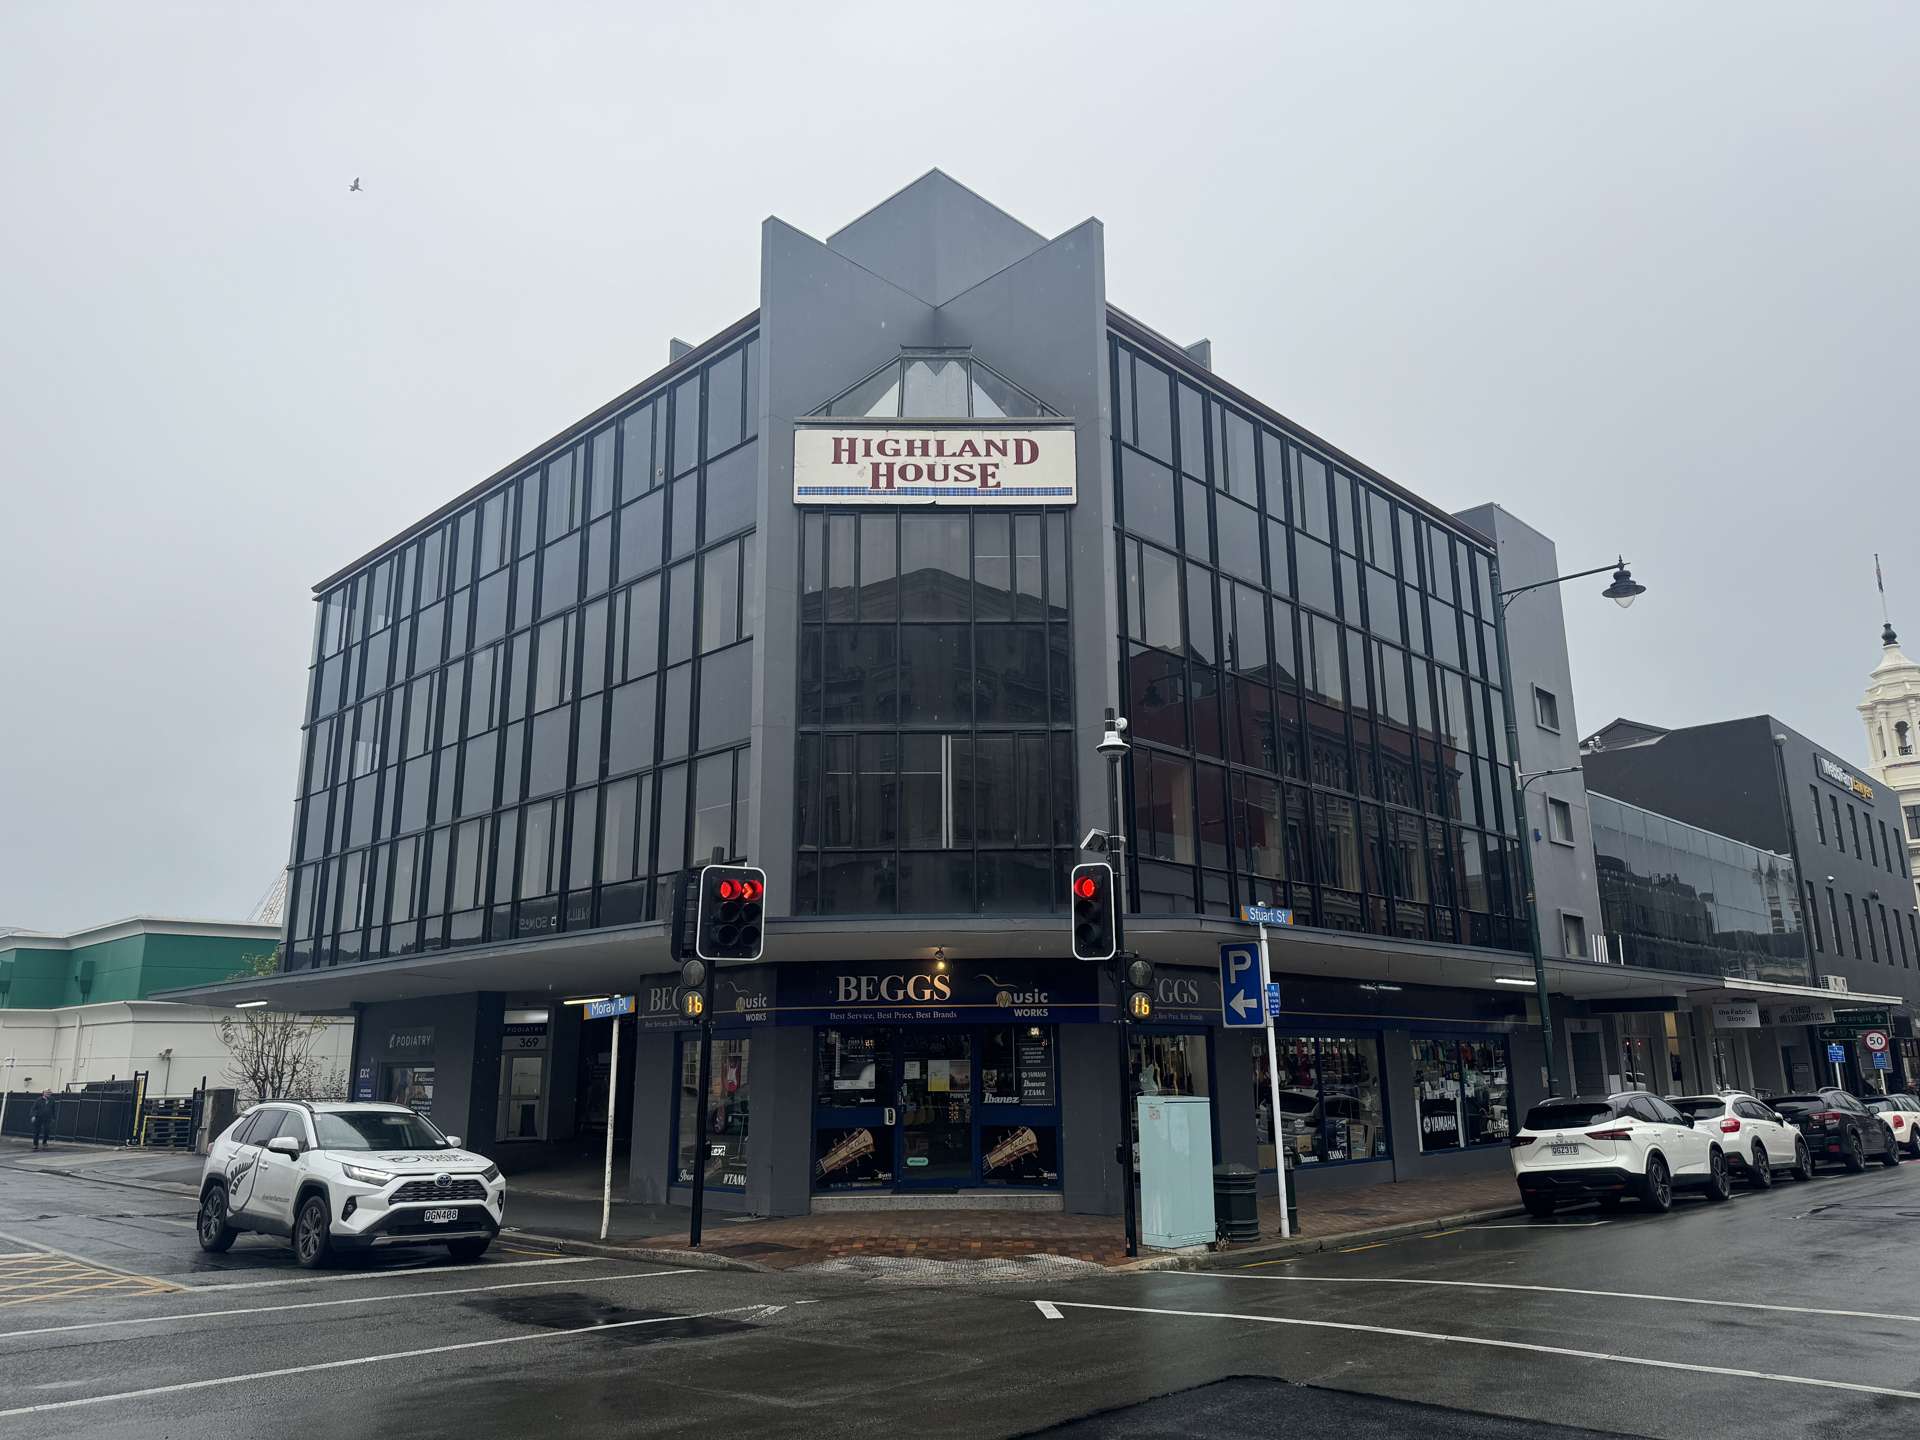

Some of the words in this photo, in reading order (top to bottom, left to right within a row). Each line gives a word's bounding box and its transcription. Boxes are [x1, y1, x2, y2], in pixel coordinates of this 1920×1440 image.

[832, 437, 1040, 465] HIGHLAND
[869, 462, 1002, 490] HOUSE
[1249, 907, 1274, 922] Stuart
[1276, 910, 1286, 923] St
[1228, 950, 1252, 984] P
[836, 974, 950, 1002] BEGGS
[1154, 978, 1199, 1004] GGS
[591, 1001, 616, 1016] Moray
[618, 997, 627, 1012] Pl
[1013, 1008, 1049, 1017] WORKS
[745, 1013, 768, 1022] WORKS
[830, 1013, 845, 1021] Best
[847, 1012, 875, 1022] Service,
[877, 1011, 892, 1020] Best
[894, 1010, 914, 1020] Price,
[916, 1010, 931, 1019] Best
[933, 1009, 958, 1019] Brands
[506, 1025, 544, 1033] PODIATRY
[396, 1034, 431, 1047] PODIATRY
[519, 1037, 539, 1048] 369
[1869, 1036, 1884, 1045] 50
[983, 1093, 1020, 1104] Ibanez
[1430, 1115, 1457, 1133] YAMAHA
